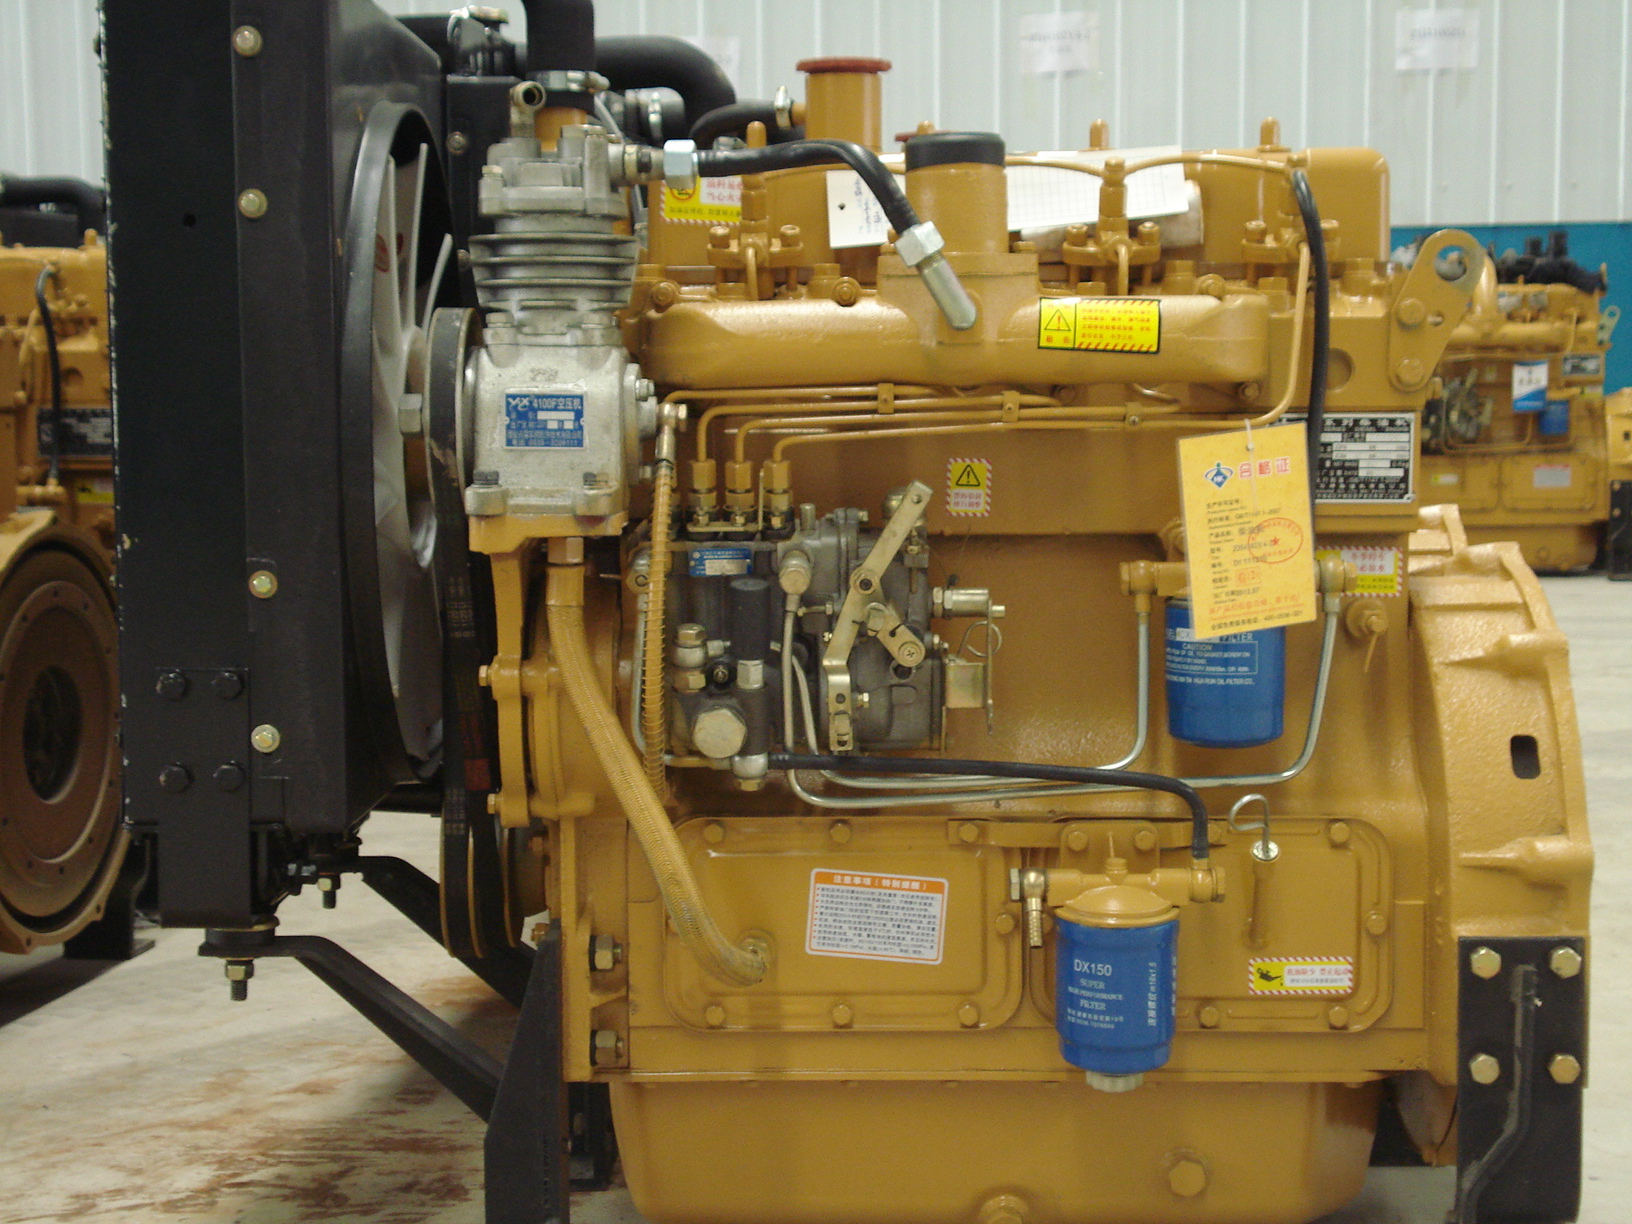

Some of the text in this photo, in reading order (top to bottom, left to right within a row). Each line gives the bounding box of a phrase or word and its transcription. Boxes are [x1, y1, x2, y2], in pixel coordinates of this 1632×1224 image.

[1239, 457, 1290, 478] 合格证
[1182, 642, 1213, 651] CAUTION
[1073, 959, 1112, 976] DX150
[1080, 978, 1105, 989] SUPER
[1080, 999, 1106, 1010] FILTER
